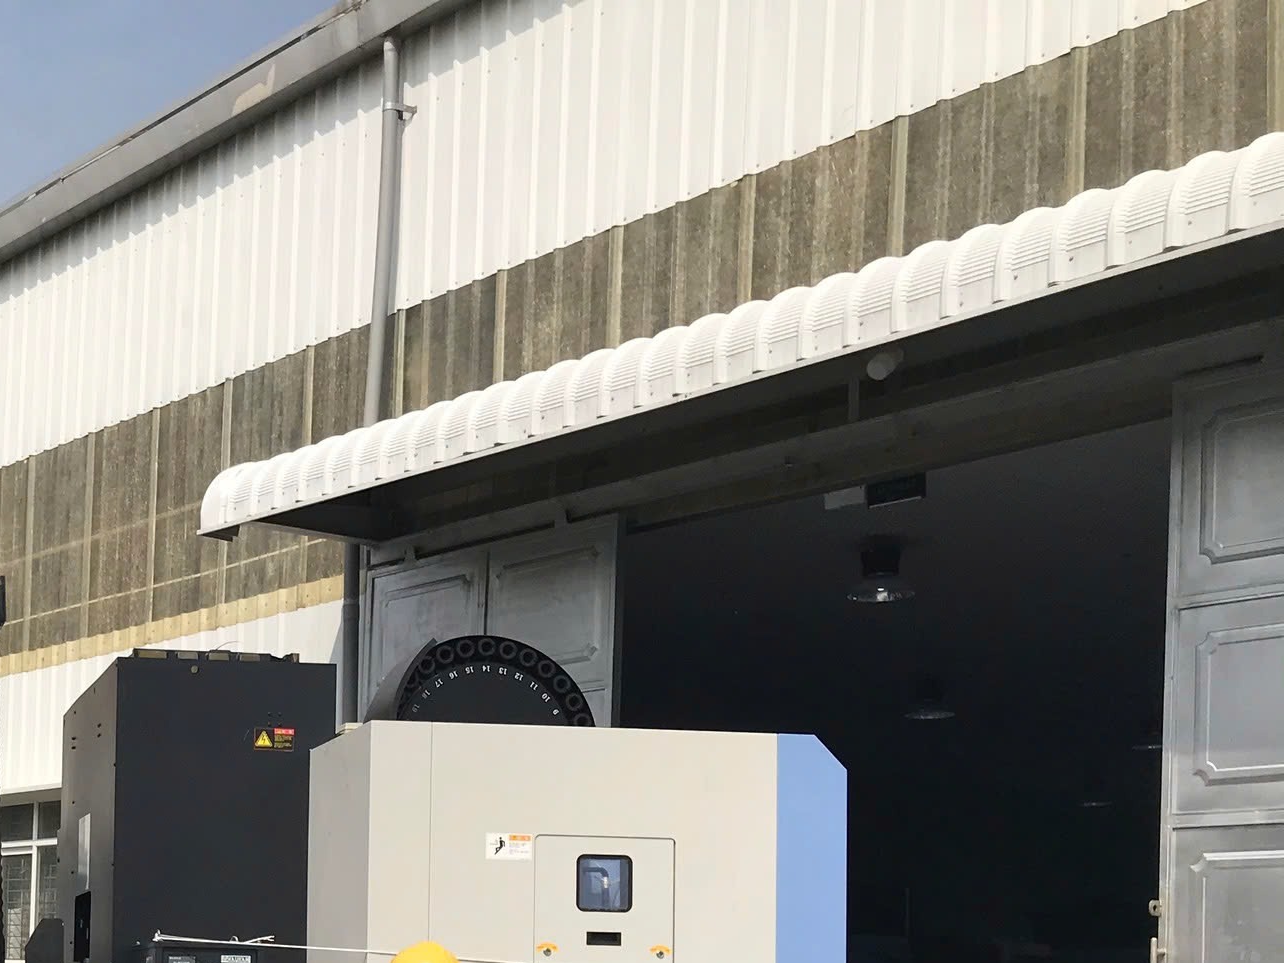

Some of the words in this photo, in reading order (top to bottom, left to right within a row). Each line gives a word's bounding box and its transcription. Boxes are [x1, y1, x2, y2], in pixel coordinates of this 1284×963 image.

[465, 666, 474, 674] 15
[498, 667, 508, 675] 13
[514, 672, 524, 681] 12
[434, 678, 444, 688] 17
[529, 681, 539, 691] 11
